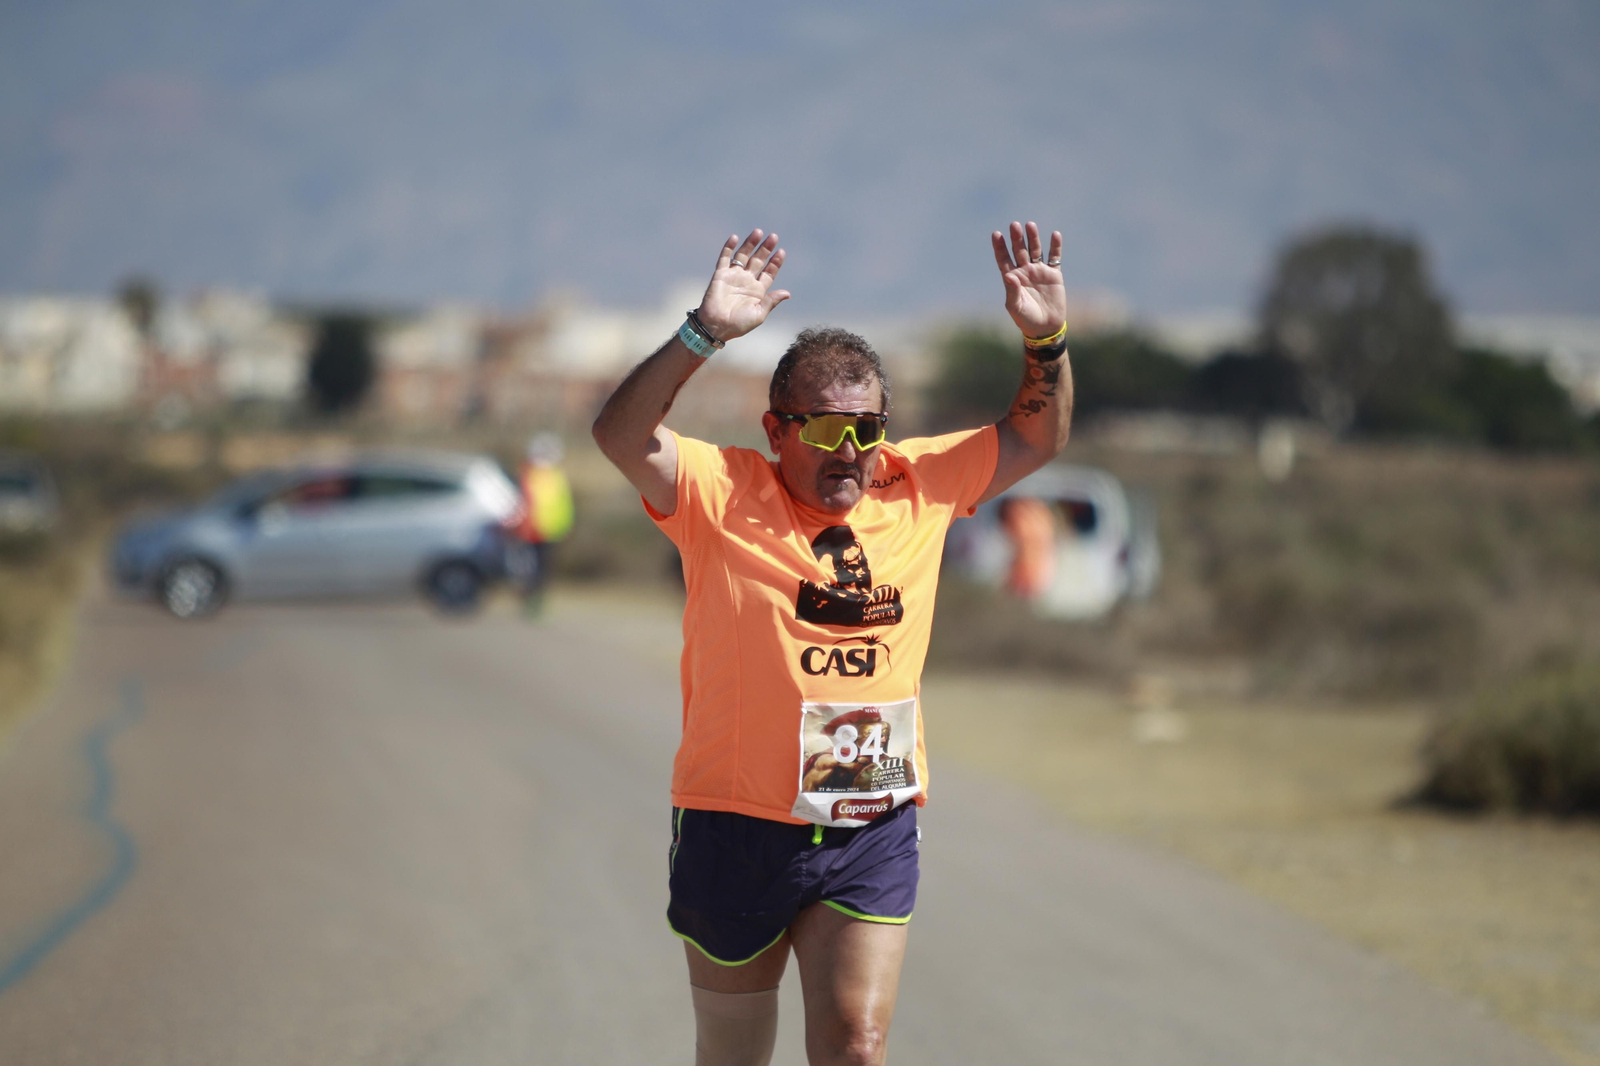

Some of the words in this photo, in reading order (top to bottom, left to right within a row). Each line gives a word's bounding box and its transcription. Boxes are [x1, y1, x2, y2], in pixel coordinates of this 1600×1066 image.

[863, 586, 895, 605] XIII
[863, 602, 894, 613] CARRERA
[863, 610, 896, 622] POPULAR
[800, 646, 877, 677] CASI
[833, 724, 884, 764] 84
[873, 757, 904, 771] XIII
[872, 767, 905, 776] CARRERA
[872, 773, 905, 782] POPULAR
